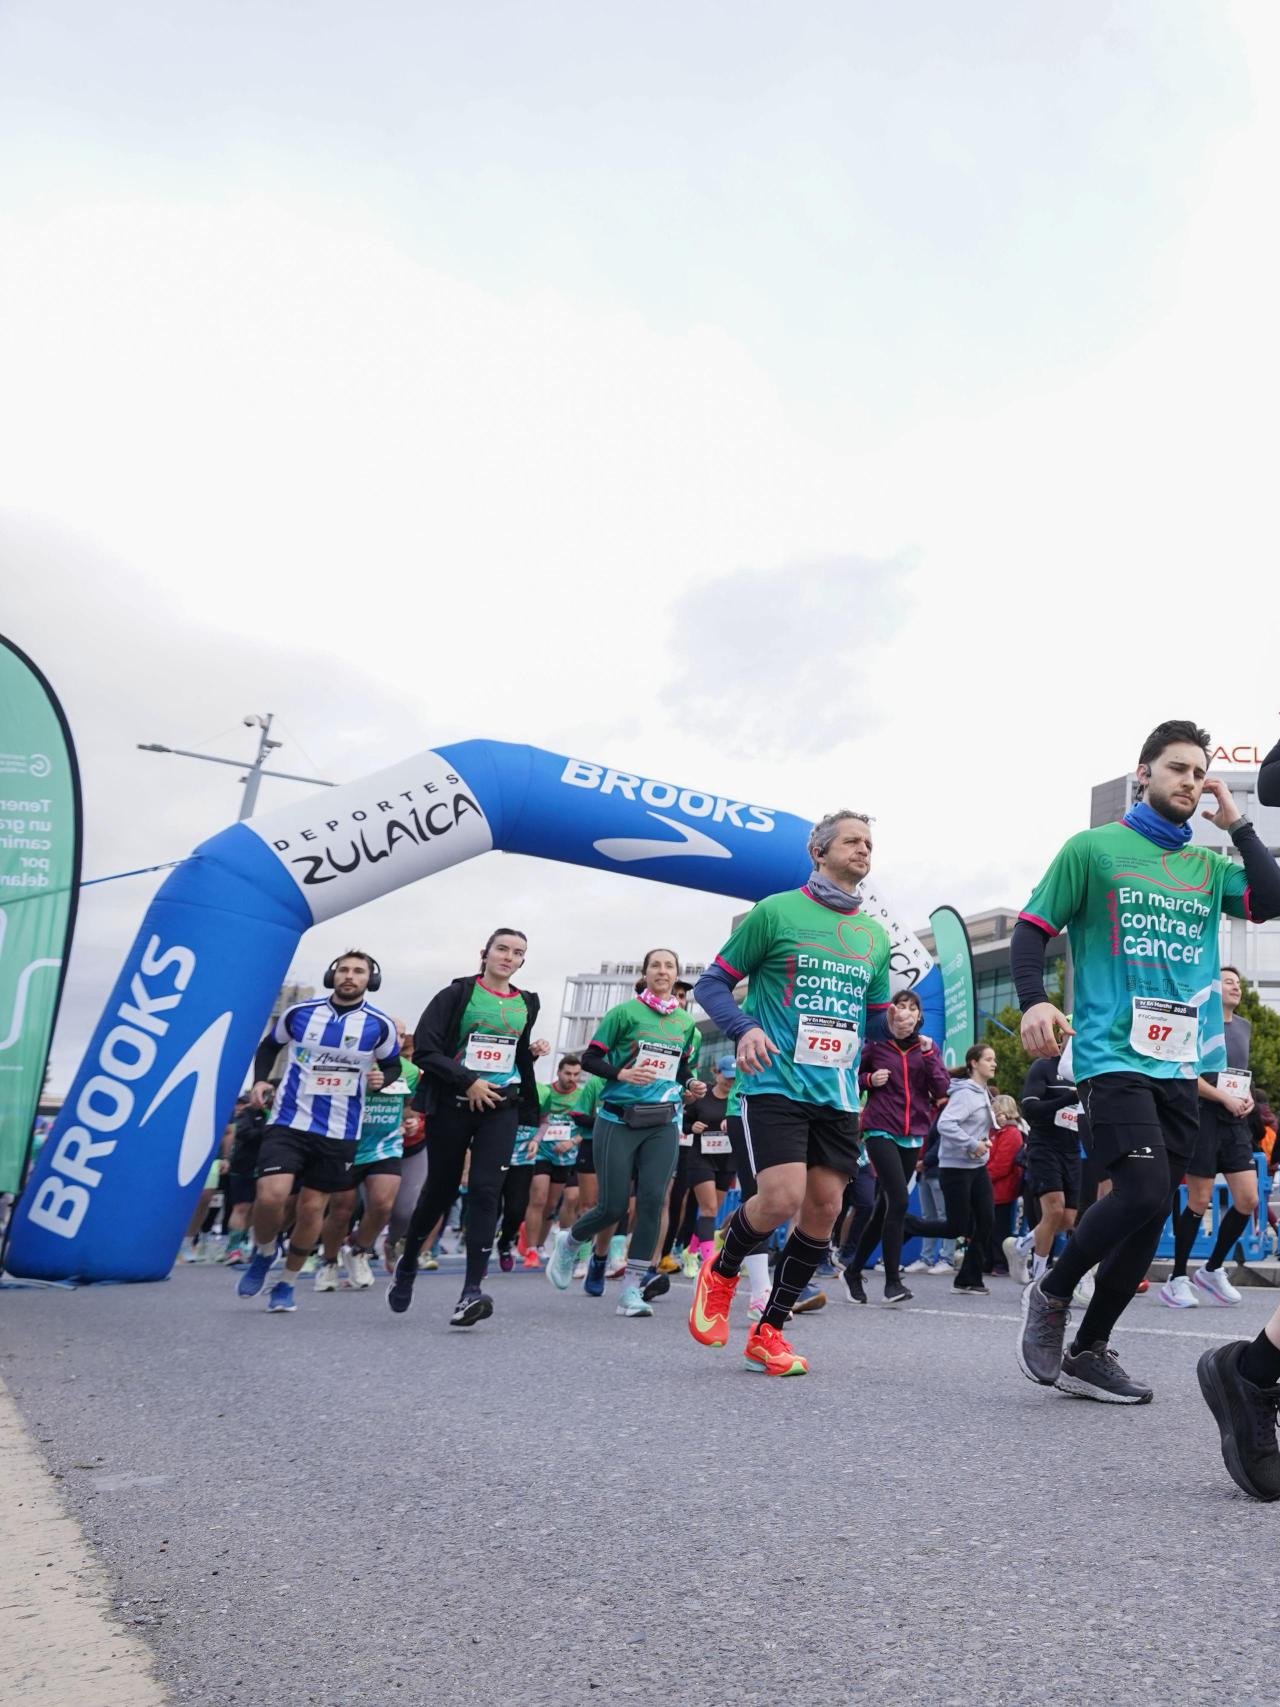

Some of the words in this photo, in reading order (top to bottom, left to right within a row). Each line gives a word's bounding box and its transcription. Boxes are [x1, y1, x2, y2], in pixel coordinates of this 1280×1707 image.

[1211, 746, 1264, 763] ACL
[561, 758, 775, 832] BROOKS
[274, 774, 460, 851] DEPORTES
[292, 793, 483, 885] ZULAICA
[1119, 887, 1143, 904] En
[1148, 893, 1210, 917] marcha
[1121, 913, 1187, 937] contra
[1188, 921, 1203, 940] el
[1123, 931, 1204, 965] cáncer
[798, 954, 818, 968] En
[822, 959, 870, 983] marcha
[796, 975, 853, 995] contra
[795, 990, 862, 1018] cáncer
[808, 1036, 842, 1052] 759
[1148, 1024, 1172, 1041] 87
[476, 1050, 501, 1061] 199
[28, 934, 196, 1239] BROOKS
[317, 1077, 341, 1086] 513
[1226, 1080, 1238, 1088] 26
